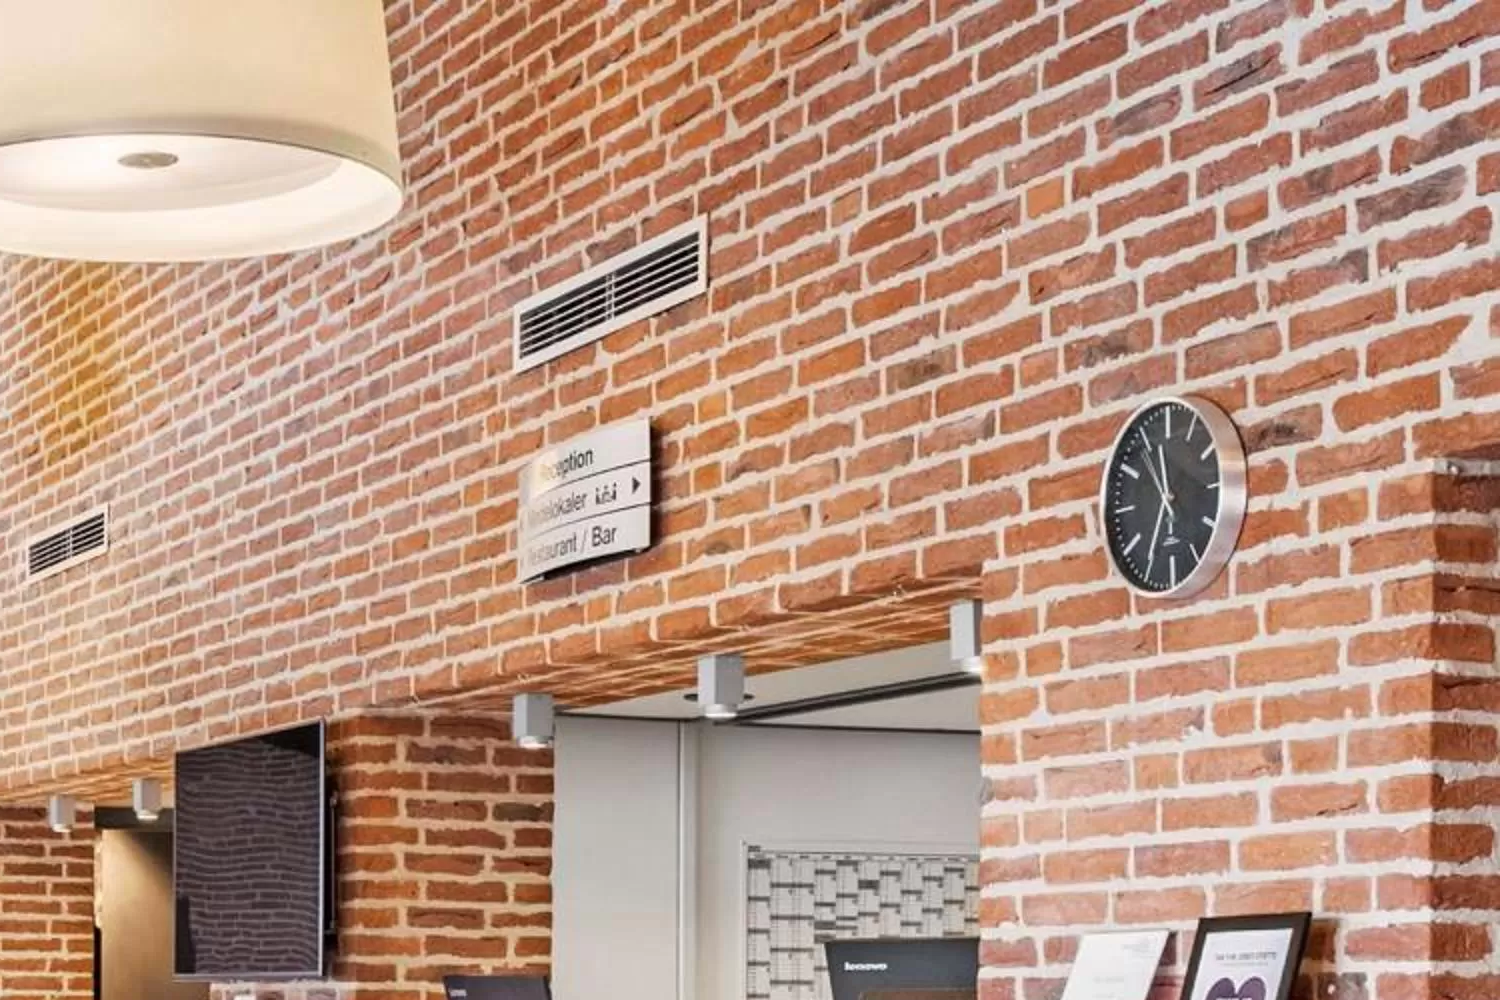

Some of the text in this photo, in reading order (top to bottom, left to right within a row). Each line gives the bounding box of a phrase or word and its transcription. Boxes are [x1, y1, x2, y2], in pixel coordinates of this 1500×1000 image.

[528, 491, 588, 526] elokaler
[529, 532, 577, 564] staurant
[592, 526, 617, 547] Bar
